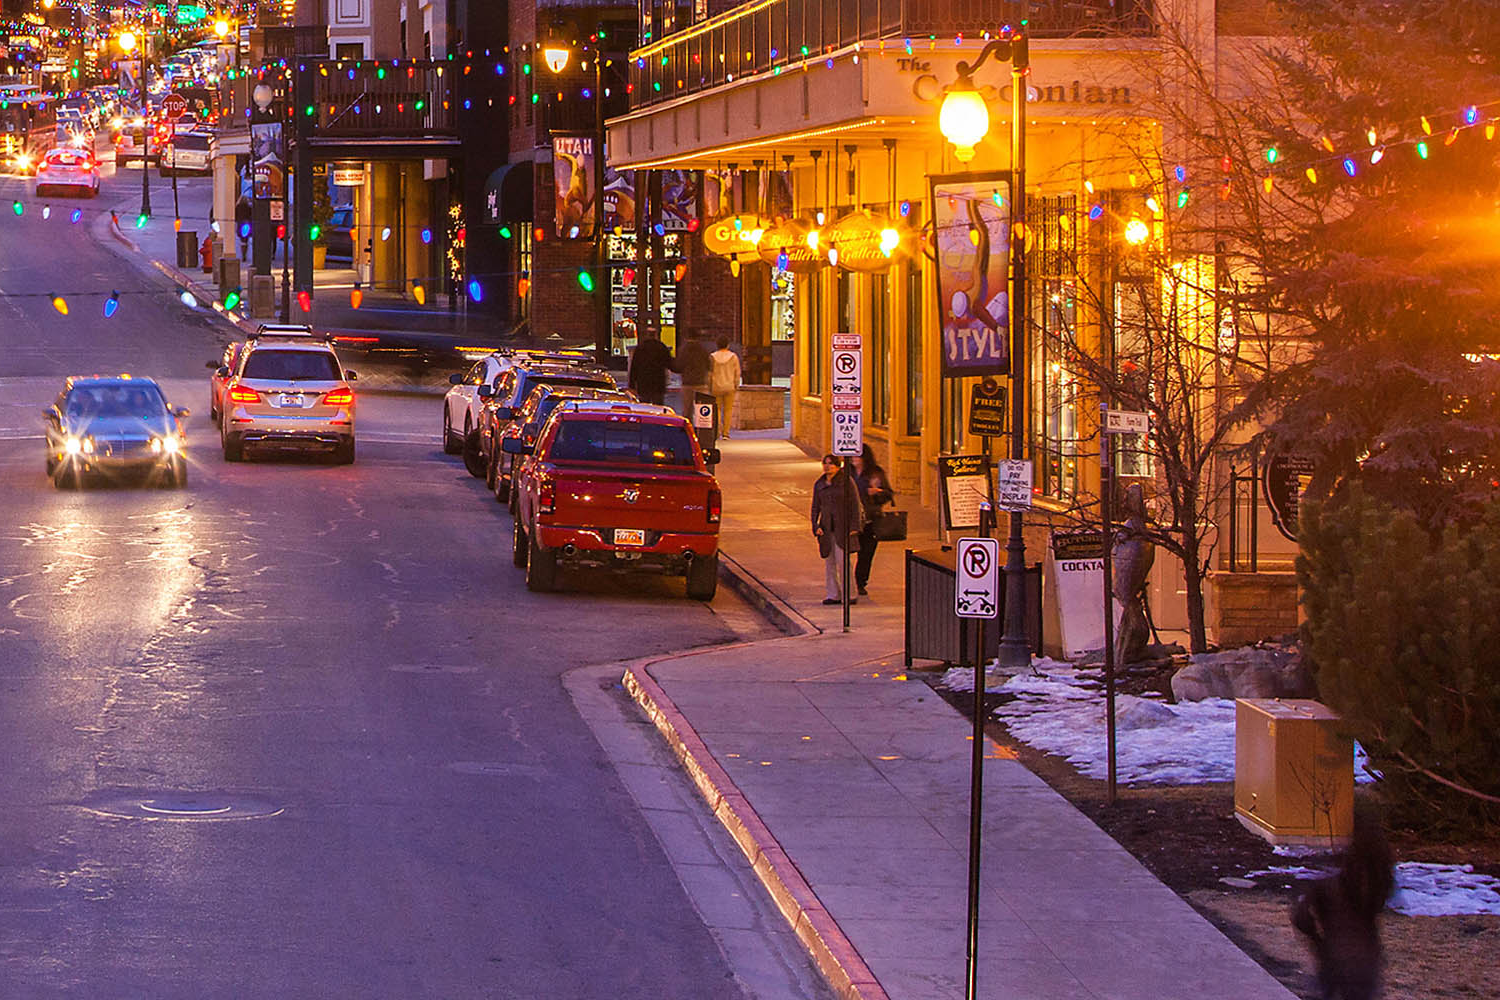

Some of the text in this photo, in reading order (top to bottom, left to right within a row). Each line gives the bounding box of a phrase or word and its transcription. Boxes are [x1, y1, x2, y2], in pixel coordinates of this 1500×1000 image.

[896, 58, 932, 72] The
[163, 101, 185, 111] STOP
[555, 139, 592, 155] UTAH
[974, 397, 1003, 407] FREE
[1062, 561, 1104, 572] COCKTA
